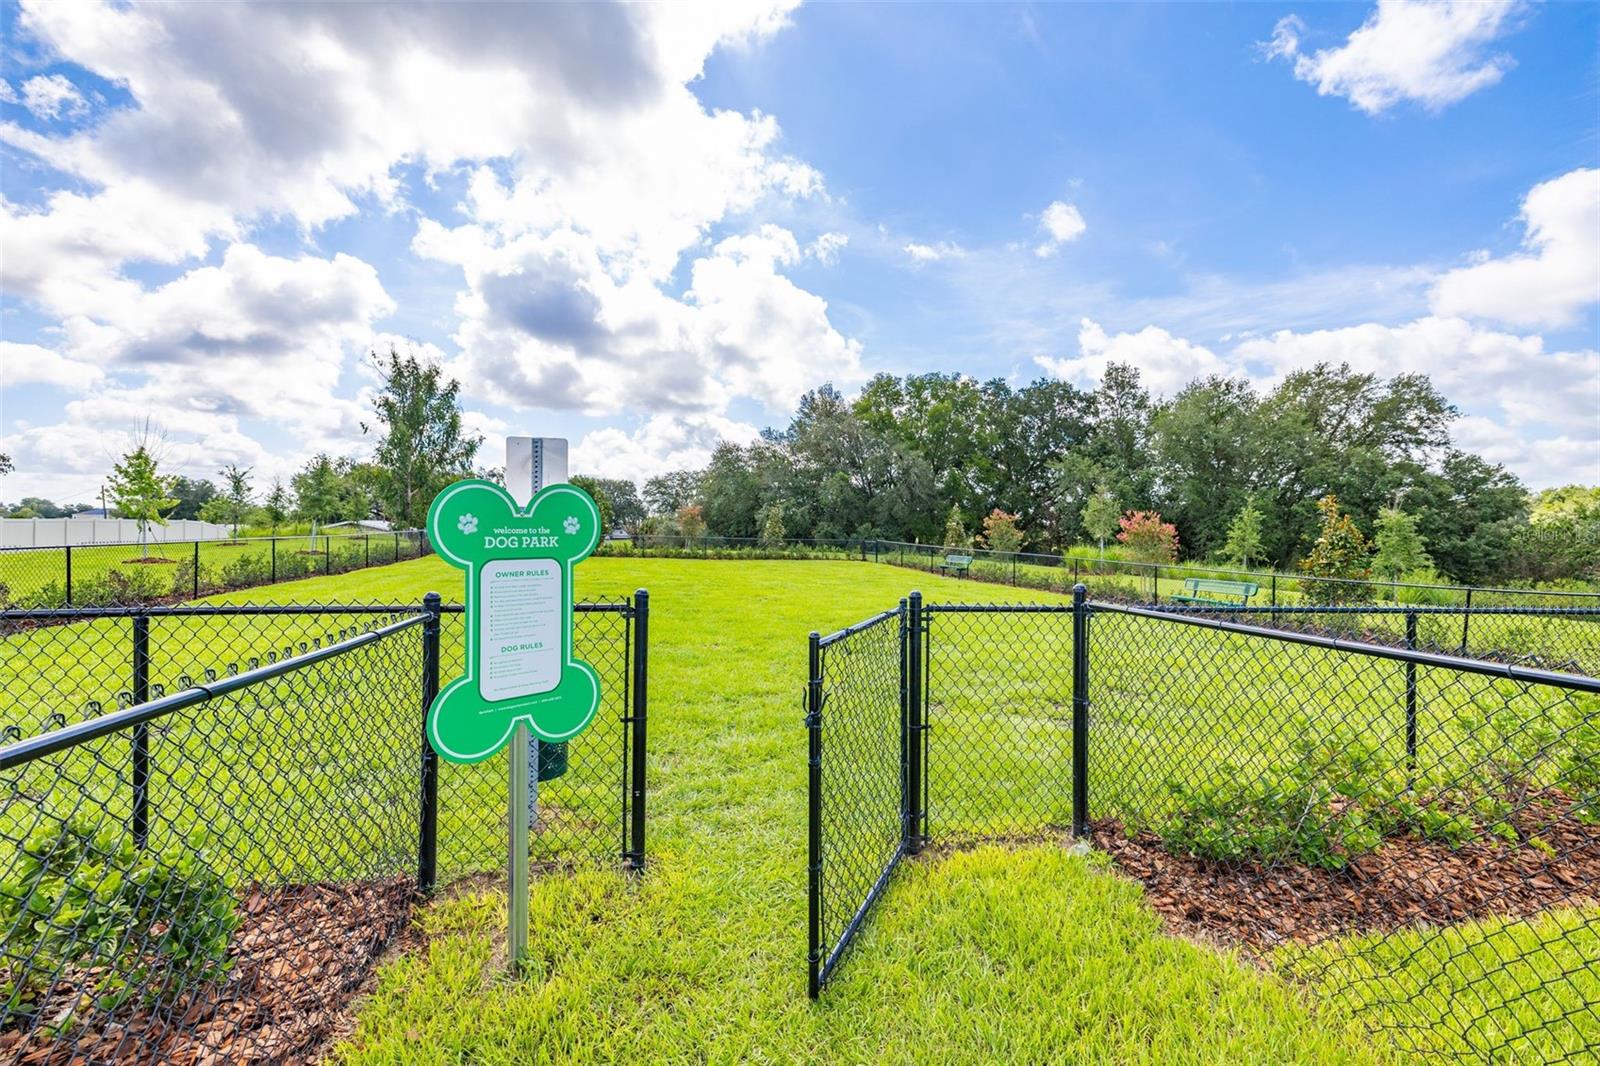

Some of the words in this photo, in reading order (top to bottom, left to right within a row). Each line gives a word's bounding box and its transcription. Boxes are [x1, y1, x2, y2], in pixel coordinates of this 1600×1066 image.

[493, 526, 528, 535] welcome
[529, 527, 537, 535] to
[538, 526, 550, 534] the
[484, 536, 519, 549] DOG
[522, 536, 559, 548] PARK
[526, 569, 550, 577] RULES
[501, 645, 518, 653] DOG
[520, 642, 544, 650] RULES
